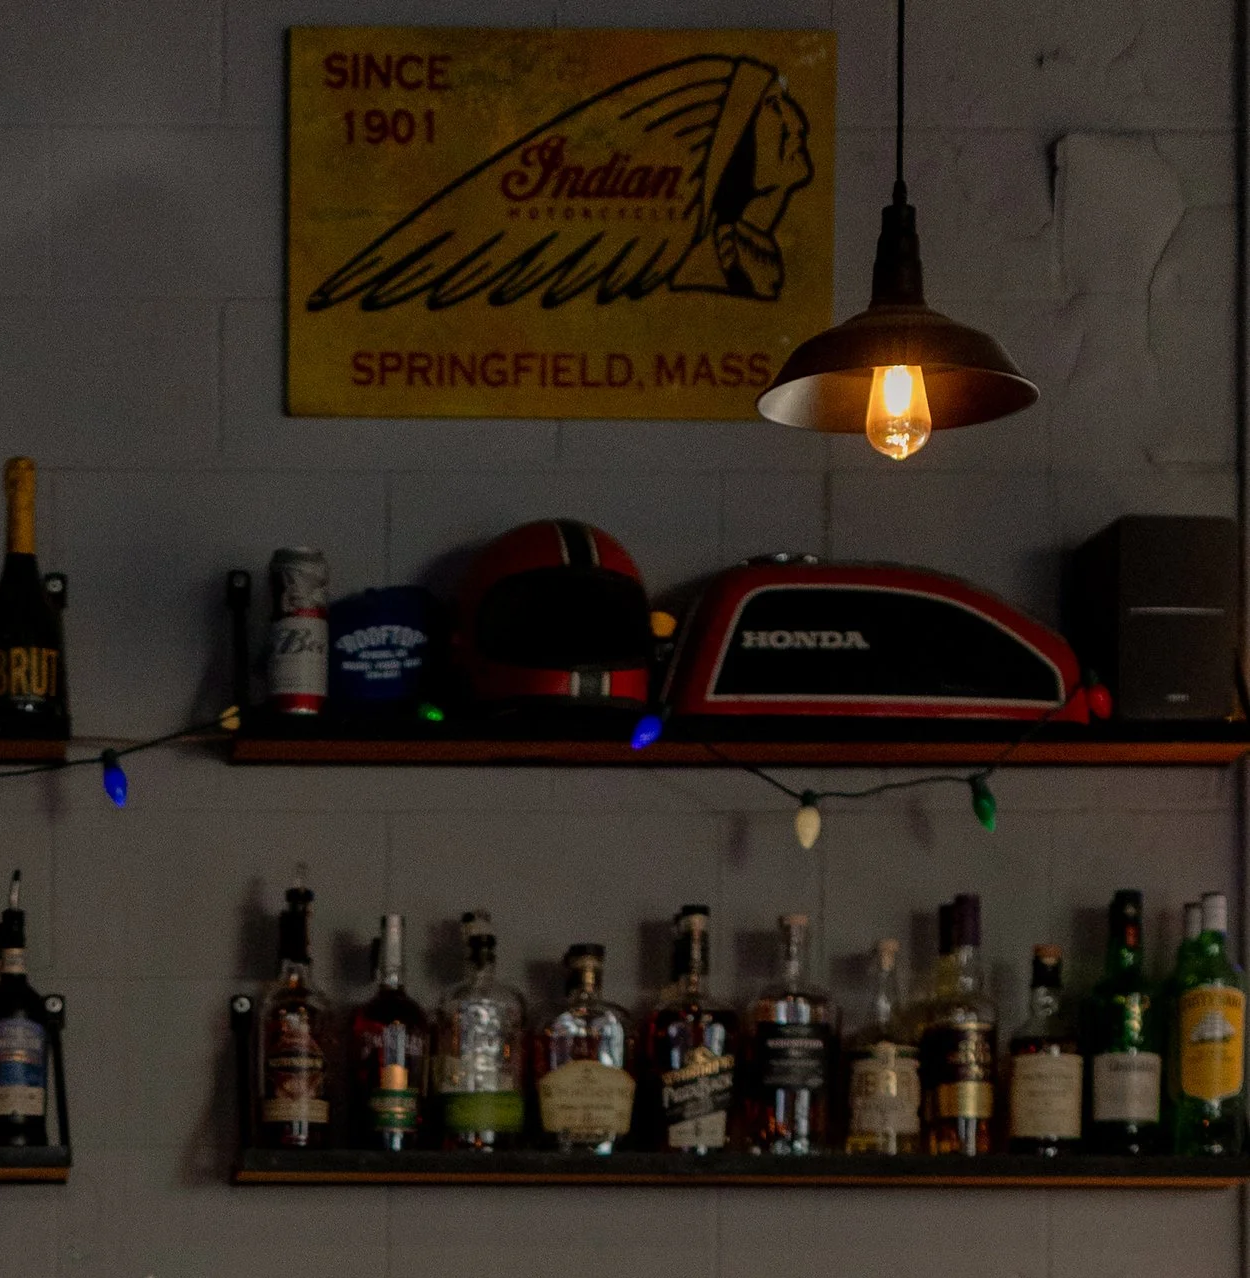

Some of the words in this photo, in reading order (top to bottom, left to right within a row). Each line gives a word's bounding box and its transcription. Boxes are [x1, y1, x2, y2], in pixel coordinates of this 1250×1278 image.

[322, 52, 452, 91] SINCE
[343, 109, 437, 145] 1901
[500, 134, 684, 205] Indian
[507, 207, 678, 221] MOTORCYCLE
[351, 351, 645, 391] SPRINGFIELD,
[740, 629, 871, 650] HONDA
